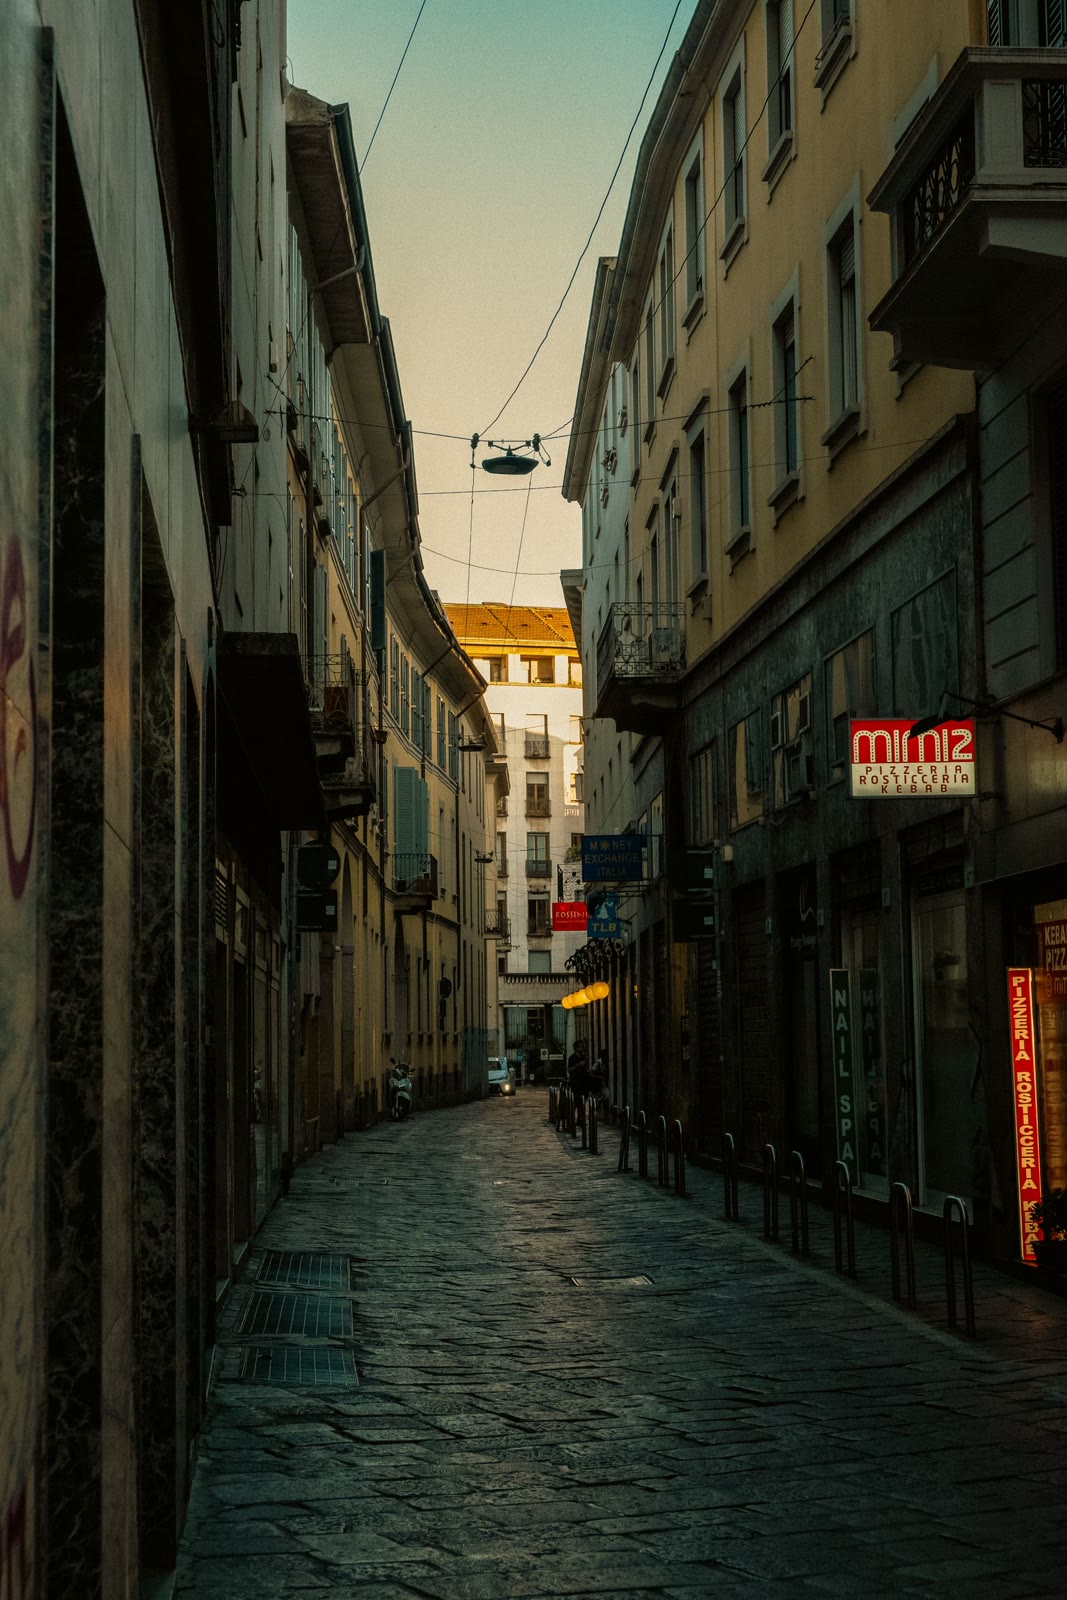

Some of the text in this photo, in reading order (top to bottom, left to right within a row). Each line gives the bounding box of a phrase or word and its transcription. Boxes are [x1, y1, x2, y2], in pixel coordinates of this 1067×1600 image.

[865, 765, 962, 776] PIZZERIA
[859, 774, 969, 784] ROSTICCERIA
[881, 784, 948, 794] KEBAB
[584, 853, 639, 864] EXCHANGE
[555, 911, 588, 919] ROSSINI
[1044, 924, 1067, 946] KEBA
[1045, 947, 1067, 971] PIZZ
[1011, 975, 1030, 1062] PIZZERIA
[834, 989, 854, 1160] NAIL SPA
[1016, 1071, 1038, 1190] ROSTICCERIA
